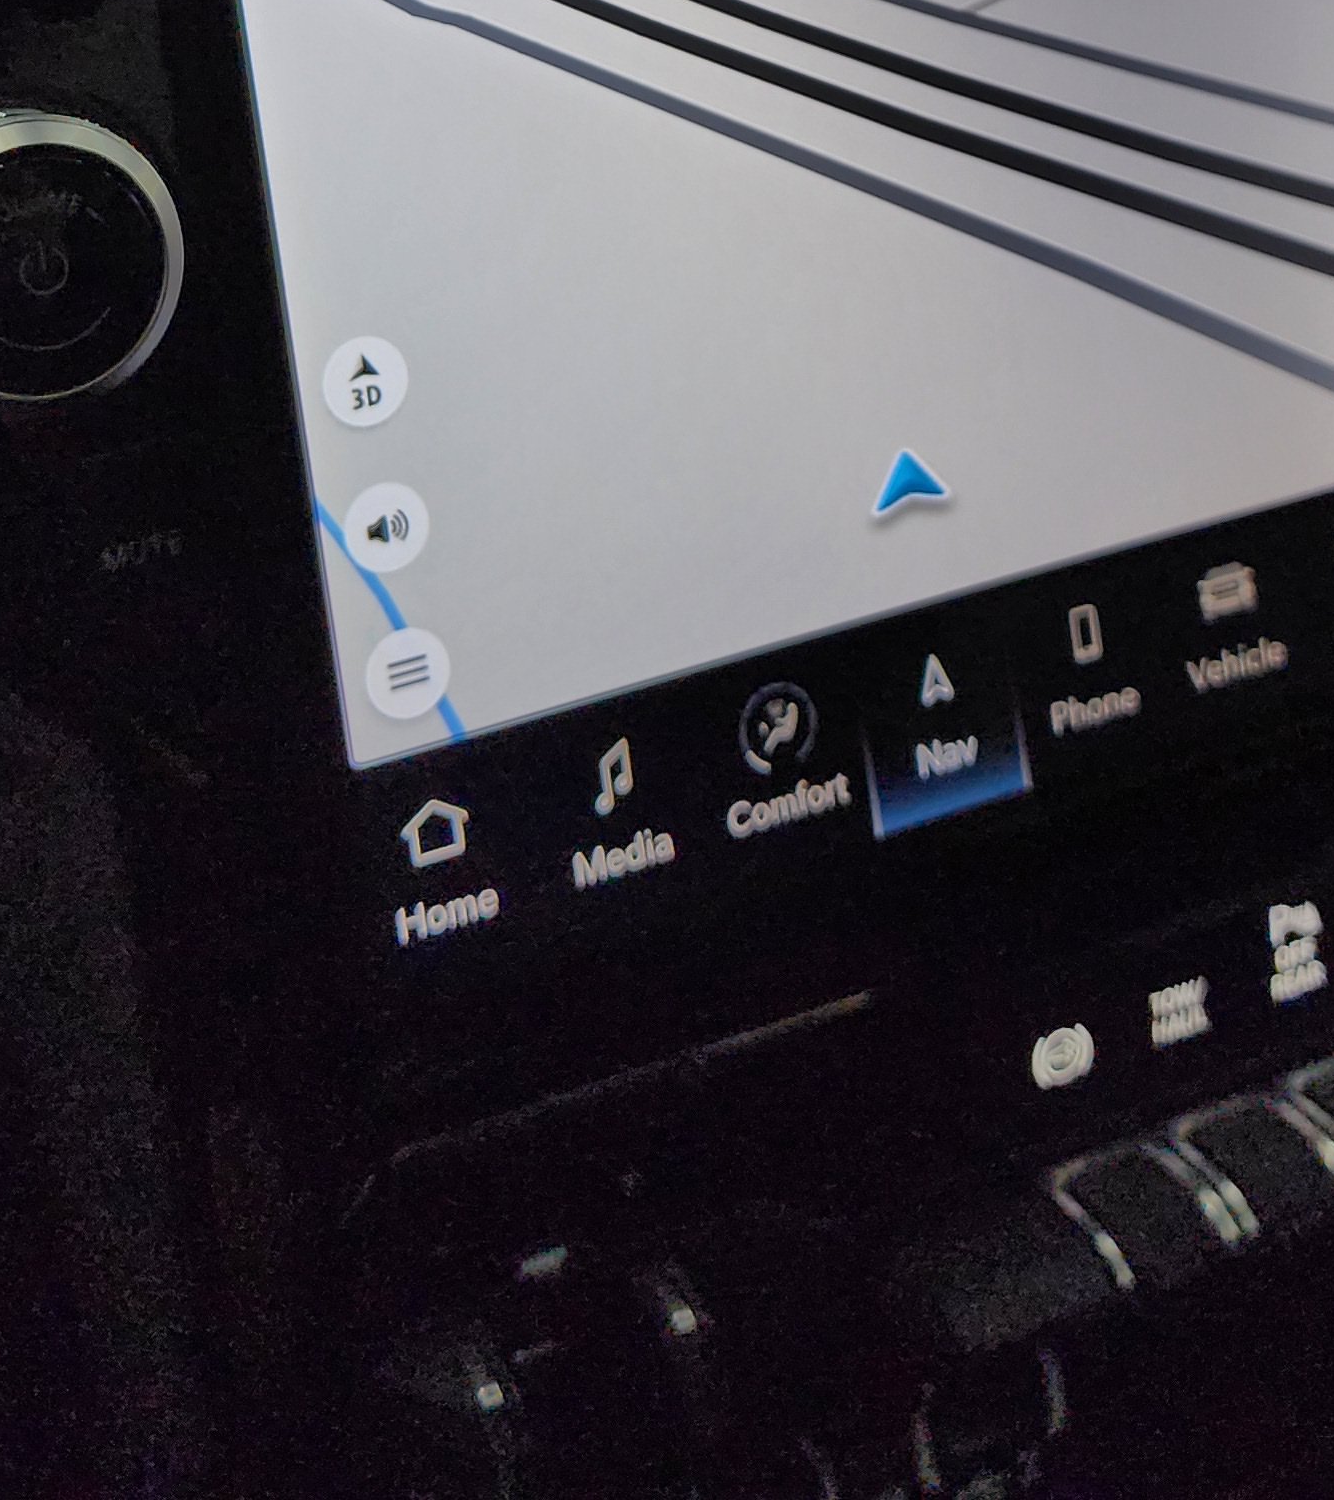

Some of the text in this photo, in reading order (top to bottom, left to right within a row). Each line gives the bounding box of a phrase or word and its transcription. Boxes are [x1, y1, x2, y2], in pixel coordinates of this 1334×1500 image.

[351, 384, 382, 410] 3D
[1185, 636, 1289, 694] Vehicle
[1049, 686, 1142, 737] Phone
[915, 734, 978, 780] Nav
[726, 772, 852, 838] Comfort
[572, 827, 676, 890] Media
[395, 888, 501, 947] Home
